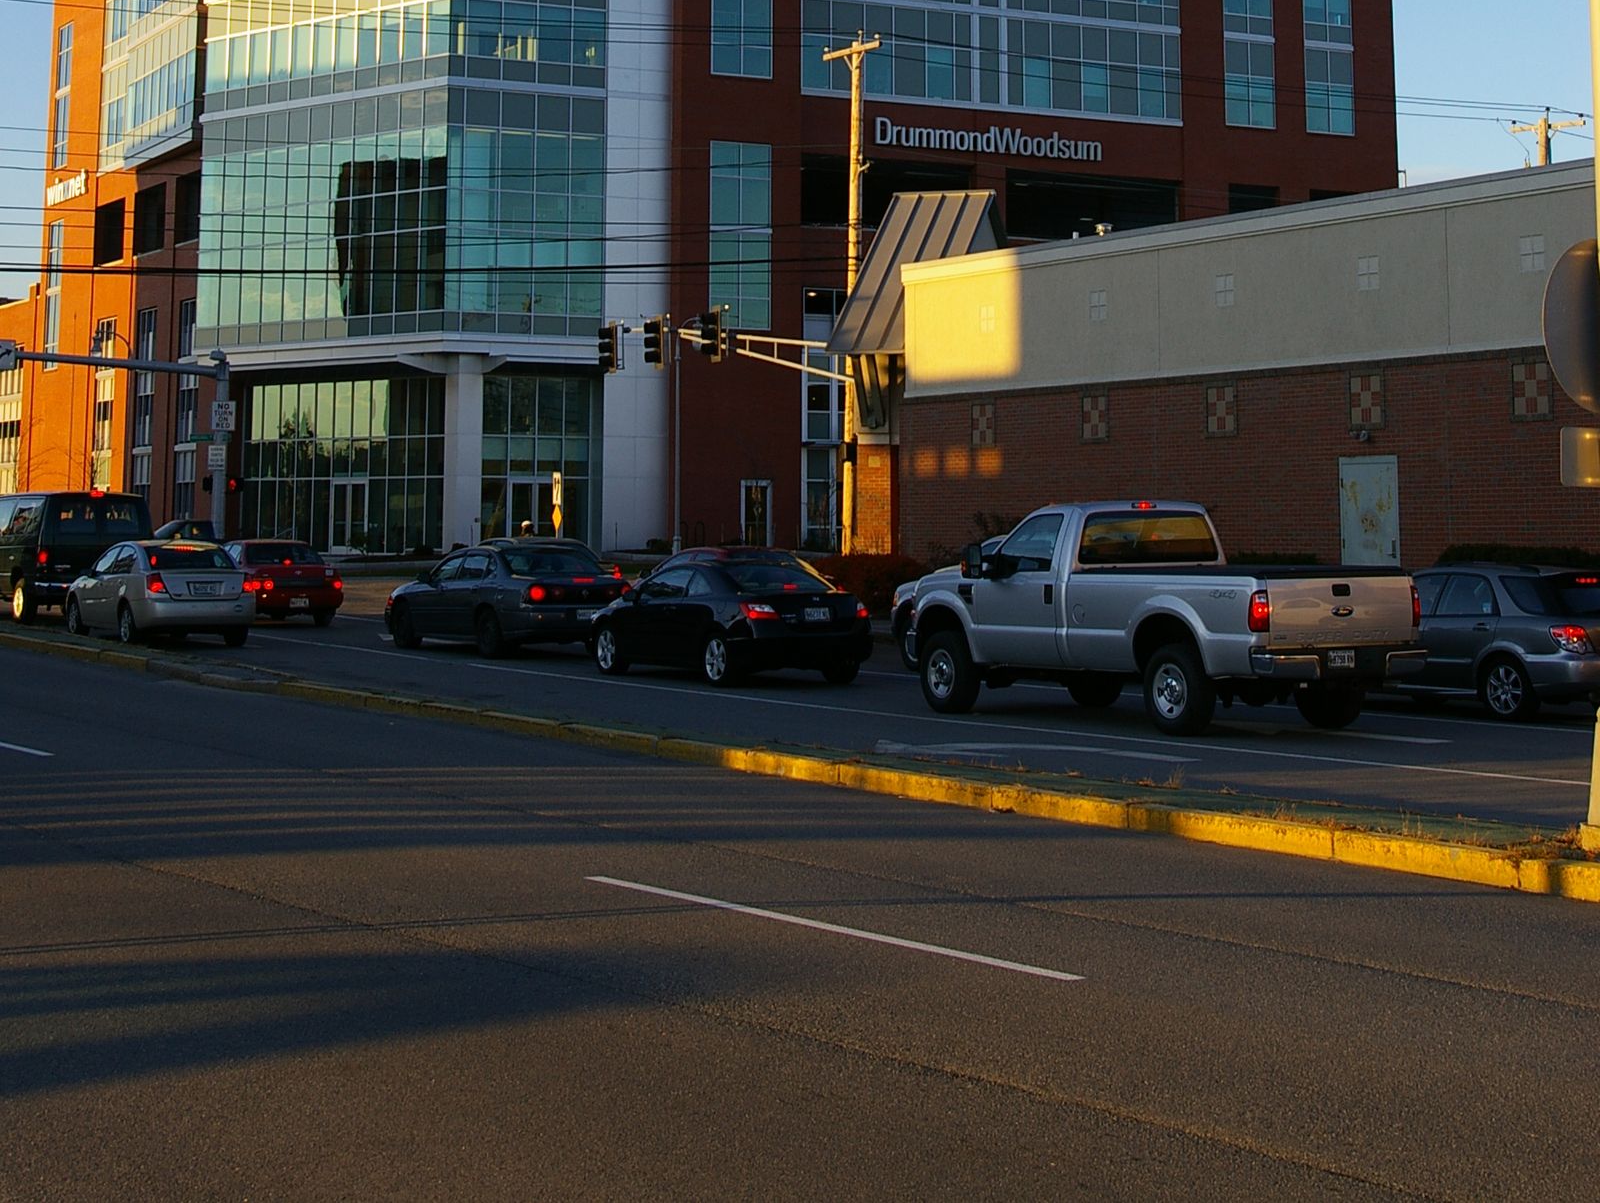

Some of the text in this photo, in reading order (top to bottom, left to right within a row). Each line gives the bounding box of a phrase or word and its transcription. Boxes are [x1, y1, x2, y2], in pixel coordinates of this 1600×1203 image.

[875, 116, 1102, 161] DrummondWoodsum
[1295, 630, 1344, 643] SUPER
[1352, 629, 1393, 641] DUTY
